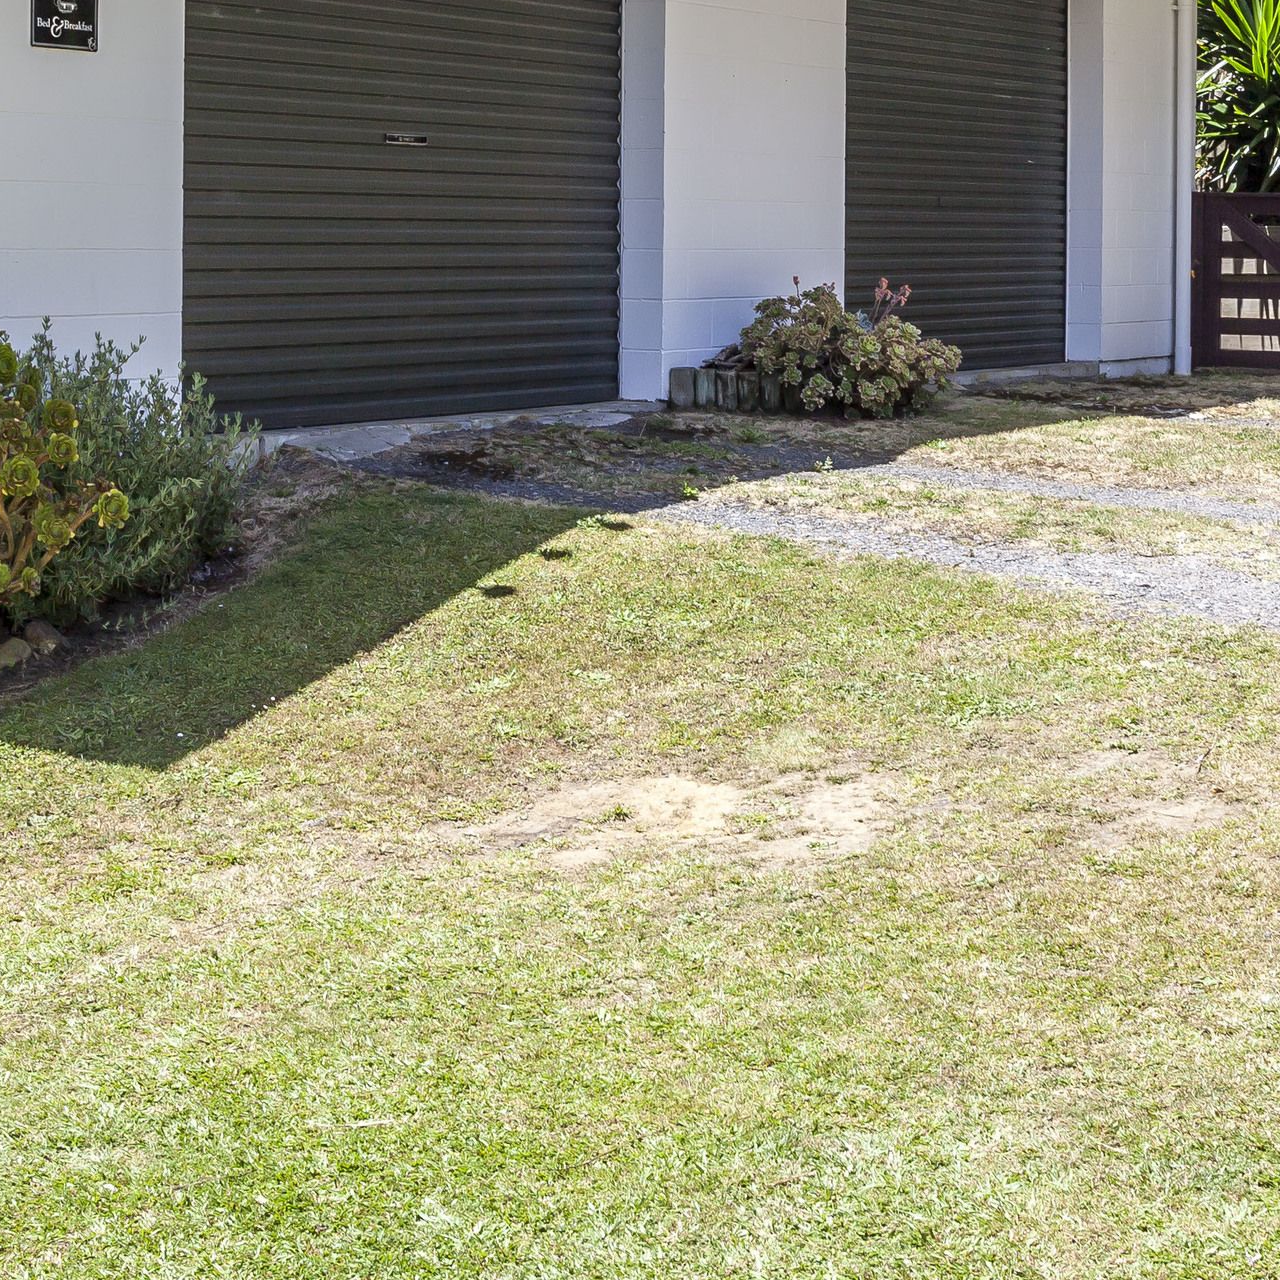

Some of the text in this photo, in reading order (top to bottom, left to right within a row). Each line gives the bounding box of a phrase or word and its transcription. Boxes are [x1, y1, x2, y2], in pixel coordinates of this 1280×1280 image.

[37, 15, 93, 38] Bed & Breakfast
